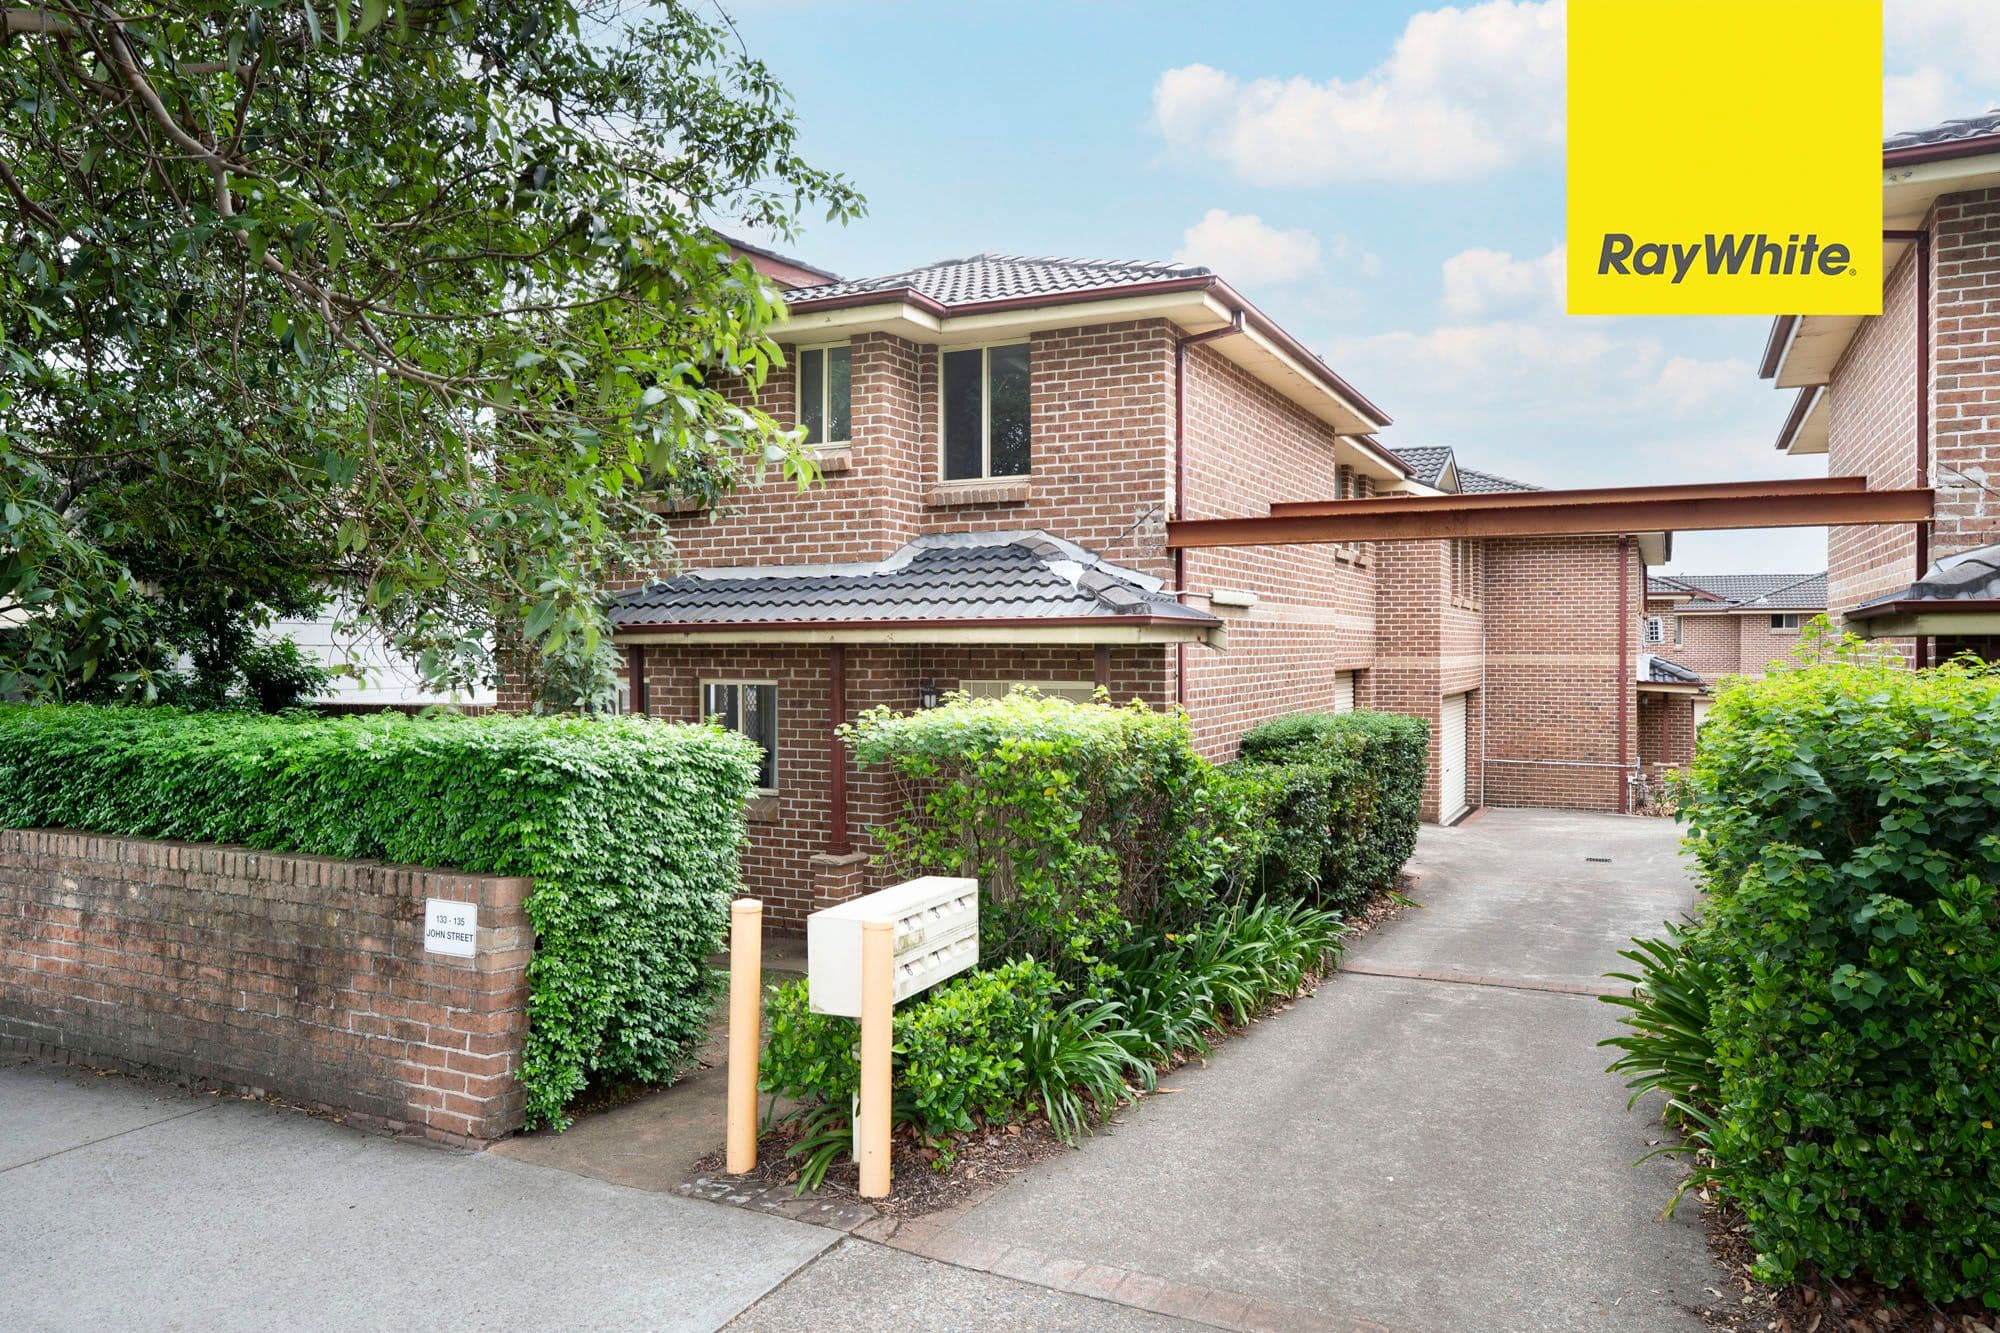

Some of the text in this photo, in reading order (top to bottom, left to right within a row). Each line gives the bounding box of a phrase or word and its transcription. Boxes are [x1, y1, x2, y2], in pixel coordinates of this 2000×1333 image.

[436, 915, 447, 924] 133
[454, 917, 465, 926] 135
[426, 929, 473, 942] JOHN STREET
